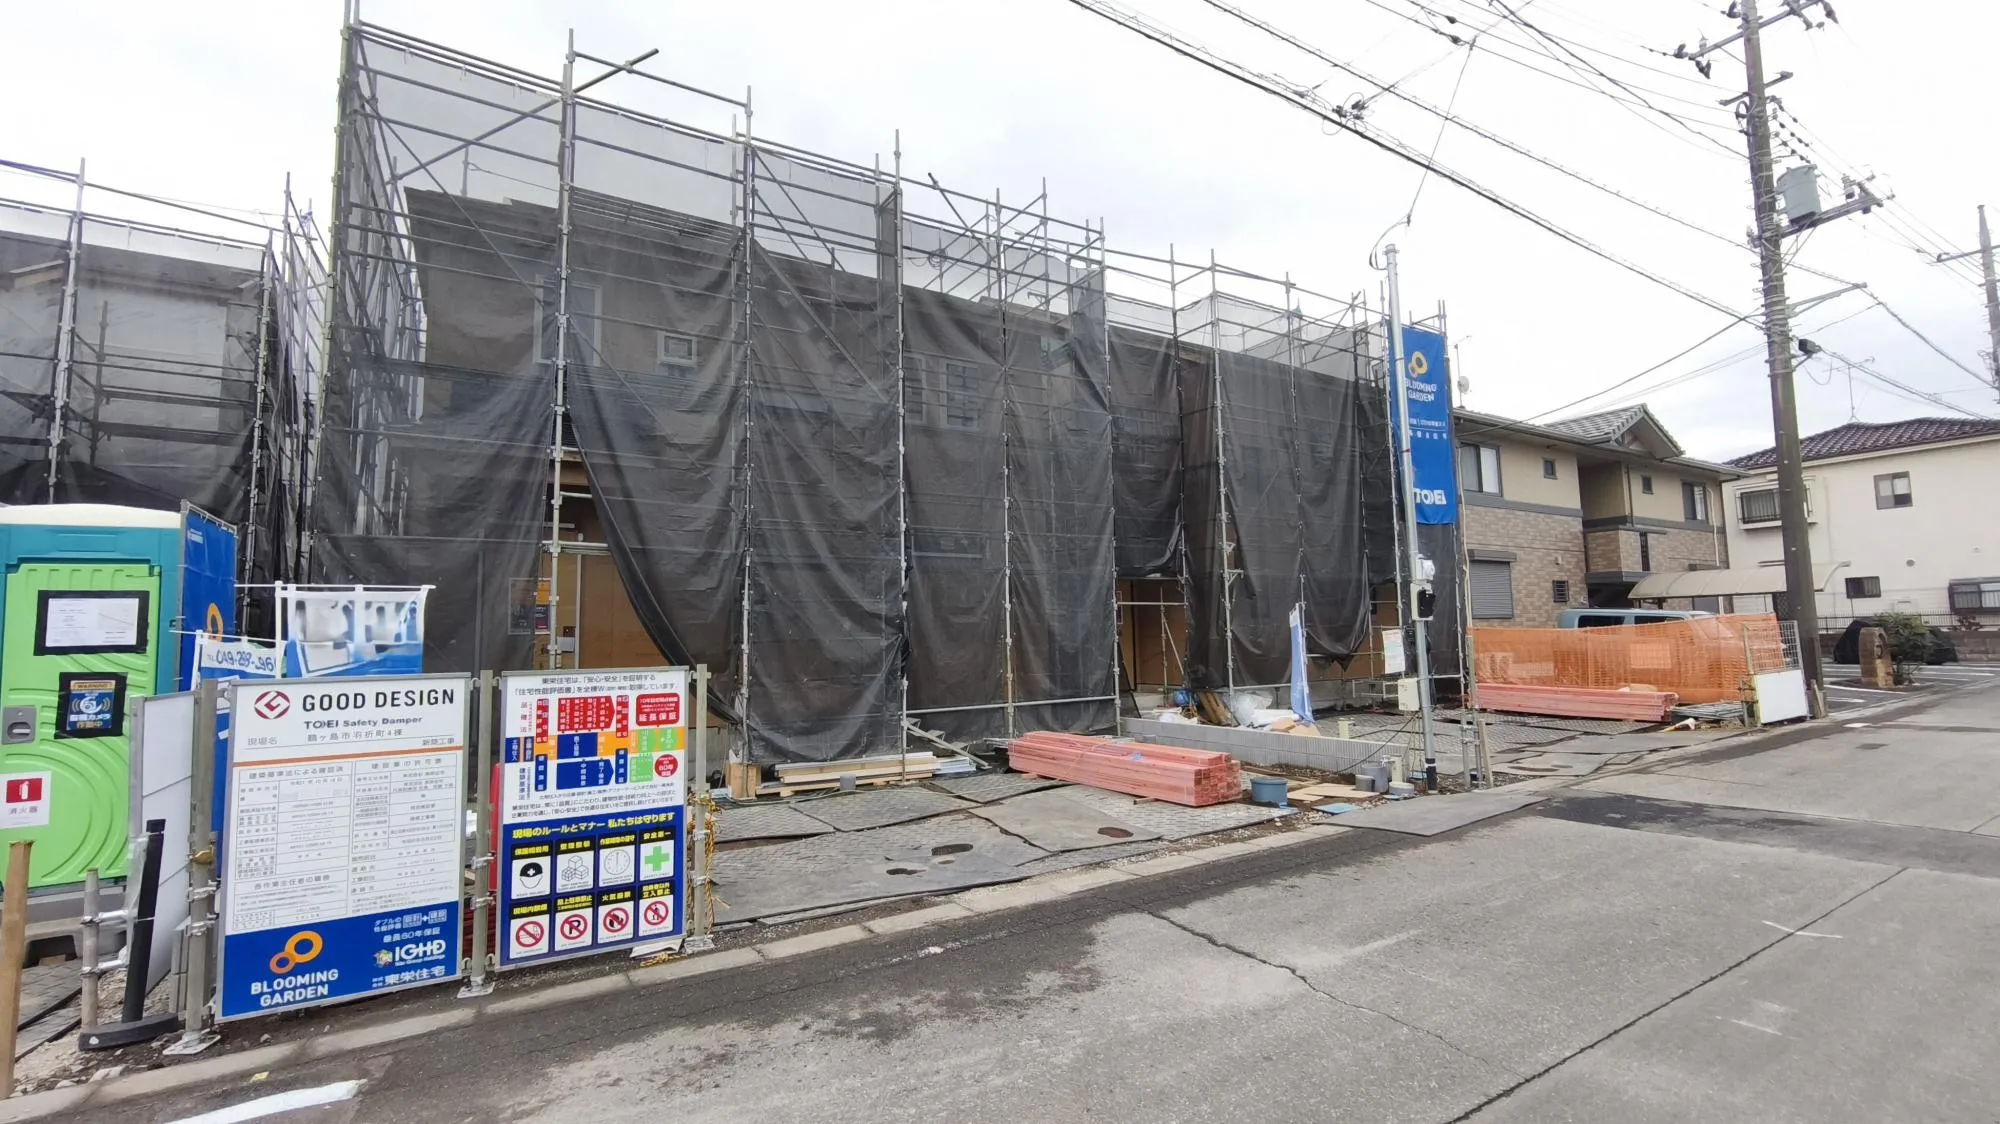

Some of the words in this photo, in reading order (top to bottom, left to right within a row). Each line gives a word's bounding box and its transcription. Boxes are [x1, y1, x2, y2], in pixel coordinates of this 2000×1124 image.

[1408, 390, 1435, 402] GARDEN
[302, 692, 366, 712] GOOD
[375, 688, 454, 708] DESIGN
[343, 719, 378, 728] Safety
[382, 717, 423, 726] Damper
[512, 821, 606, 839] 現場のルールとマナー
[608, 812, 675, 829] 私たちは守ります
[250, 968, 339, 995] BLOOMING
[385, 966, 446, 985] 東栄住宅
[260, 983, 329, 1007] GARDEN
